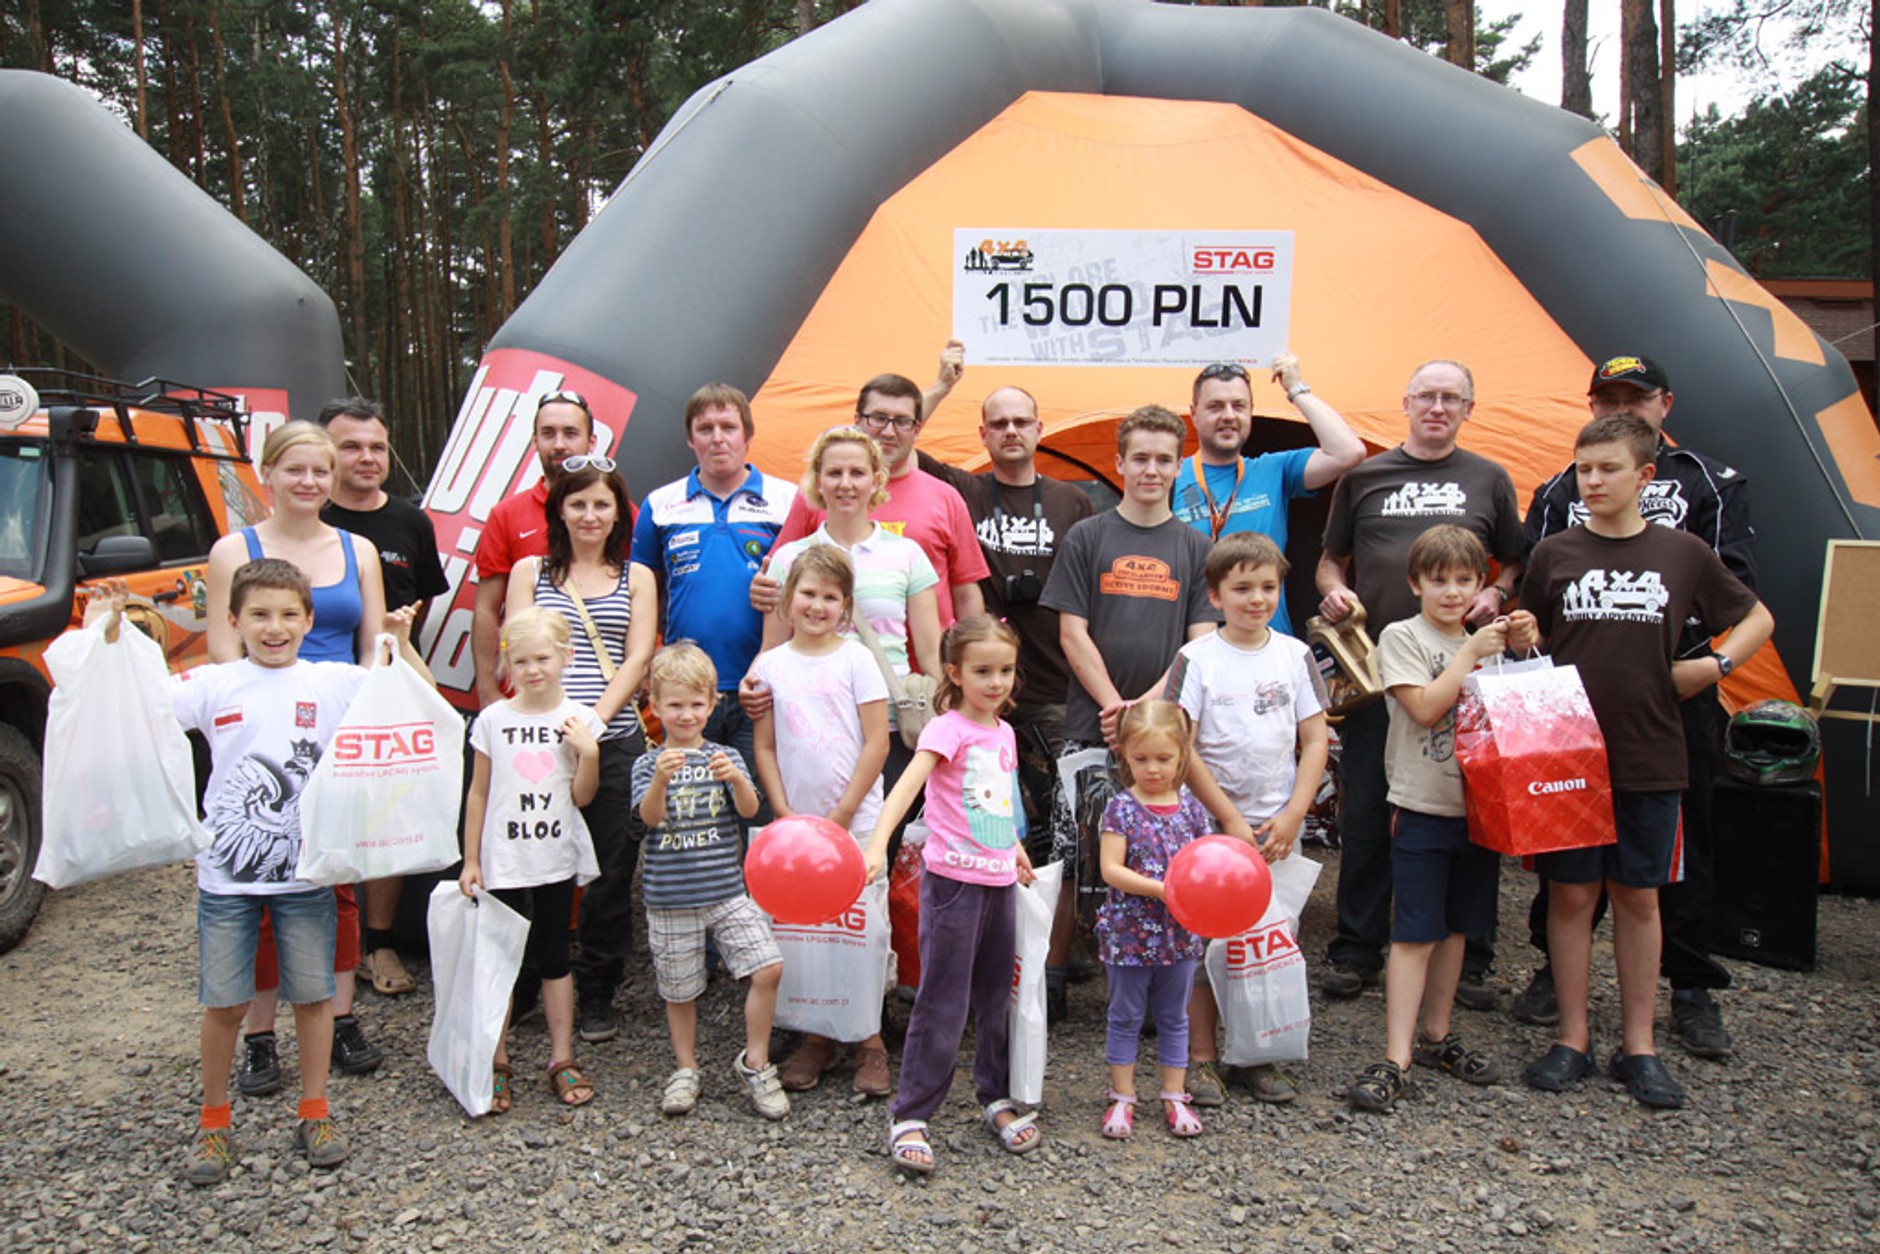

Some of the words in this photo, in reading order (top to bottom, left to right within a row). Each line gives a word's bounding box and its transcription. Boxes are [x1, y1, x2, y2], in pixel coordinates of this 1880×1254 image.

[1193, 251, 1275, 269] STAG
[986, 282, 1132, 327] 1500
[1152, 284, 1263, 328] PLN
[334, 729, 435, 760] STAG
[502, 726, 565, 745] THEY
[1528, 778, 1587, 796] Canon
[520, 793, 552, 812] MY
[507, 819, 562, 840] BLOG
[659, 827, 721, 851] POWER
[944, 851, 1016, 874] CUPCA
[1226, 929, 1298, 965] STA
